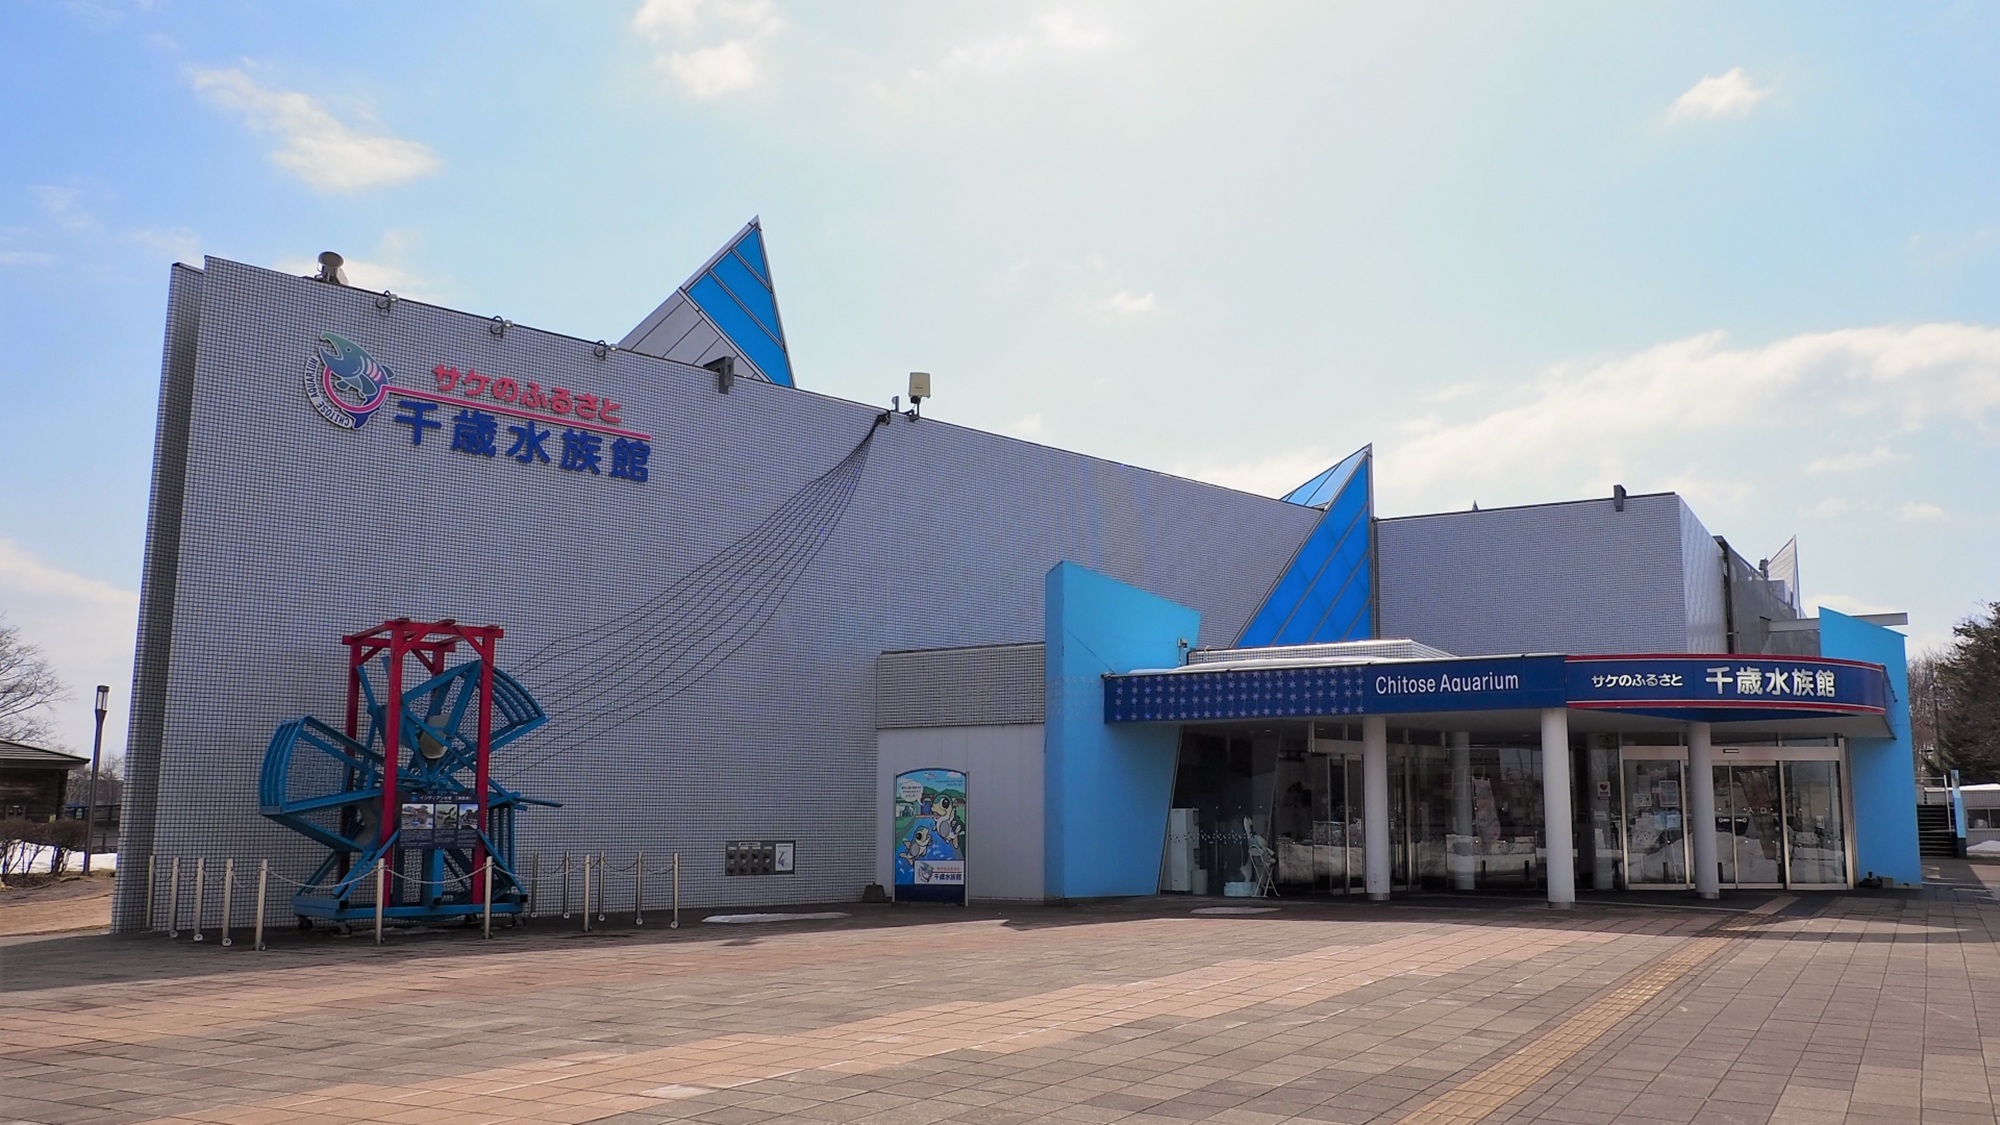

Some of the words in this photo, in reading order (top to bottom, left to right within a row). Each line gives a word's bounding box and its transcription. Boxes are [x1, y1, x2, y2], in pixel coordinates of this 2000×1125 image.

[305, 357, 319, 398] AQUARIUM
[433, 363, 621, 424] サケのふるさと
[316, 400, 350, 427] CHITOSE
[394, 400, 652, 483] 千歳水族館
[1375, 675, 1436, 695] Chitose
[1440, 672, 1519, 693] Aquarium
[1591, 673, 1684, 689] サケのふるさと
[1705, 666, 1836, 698] 千歳水族館
